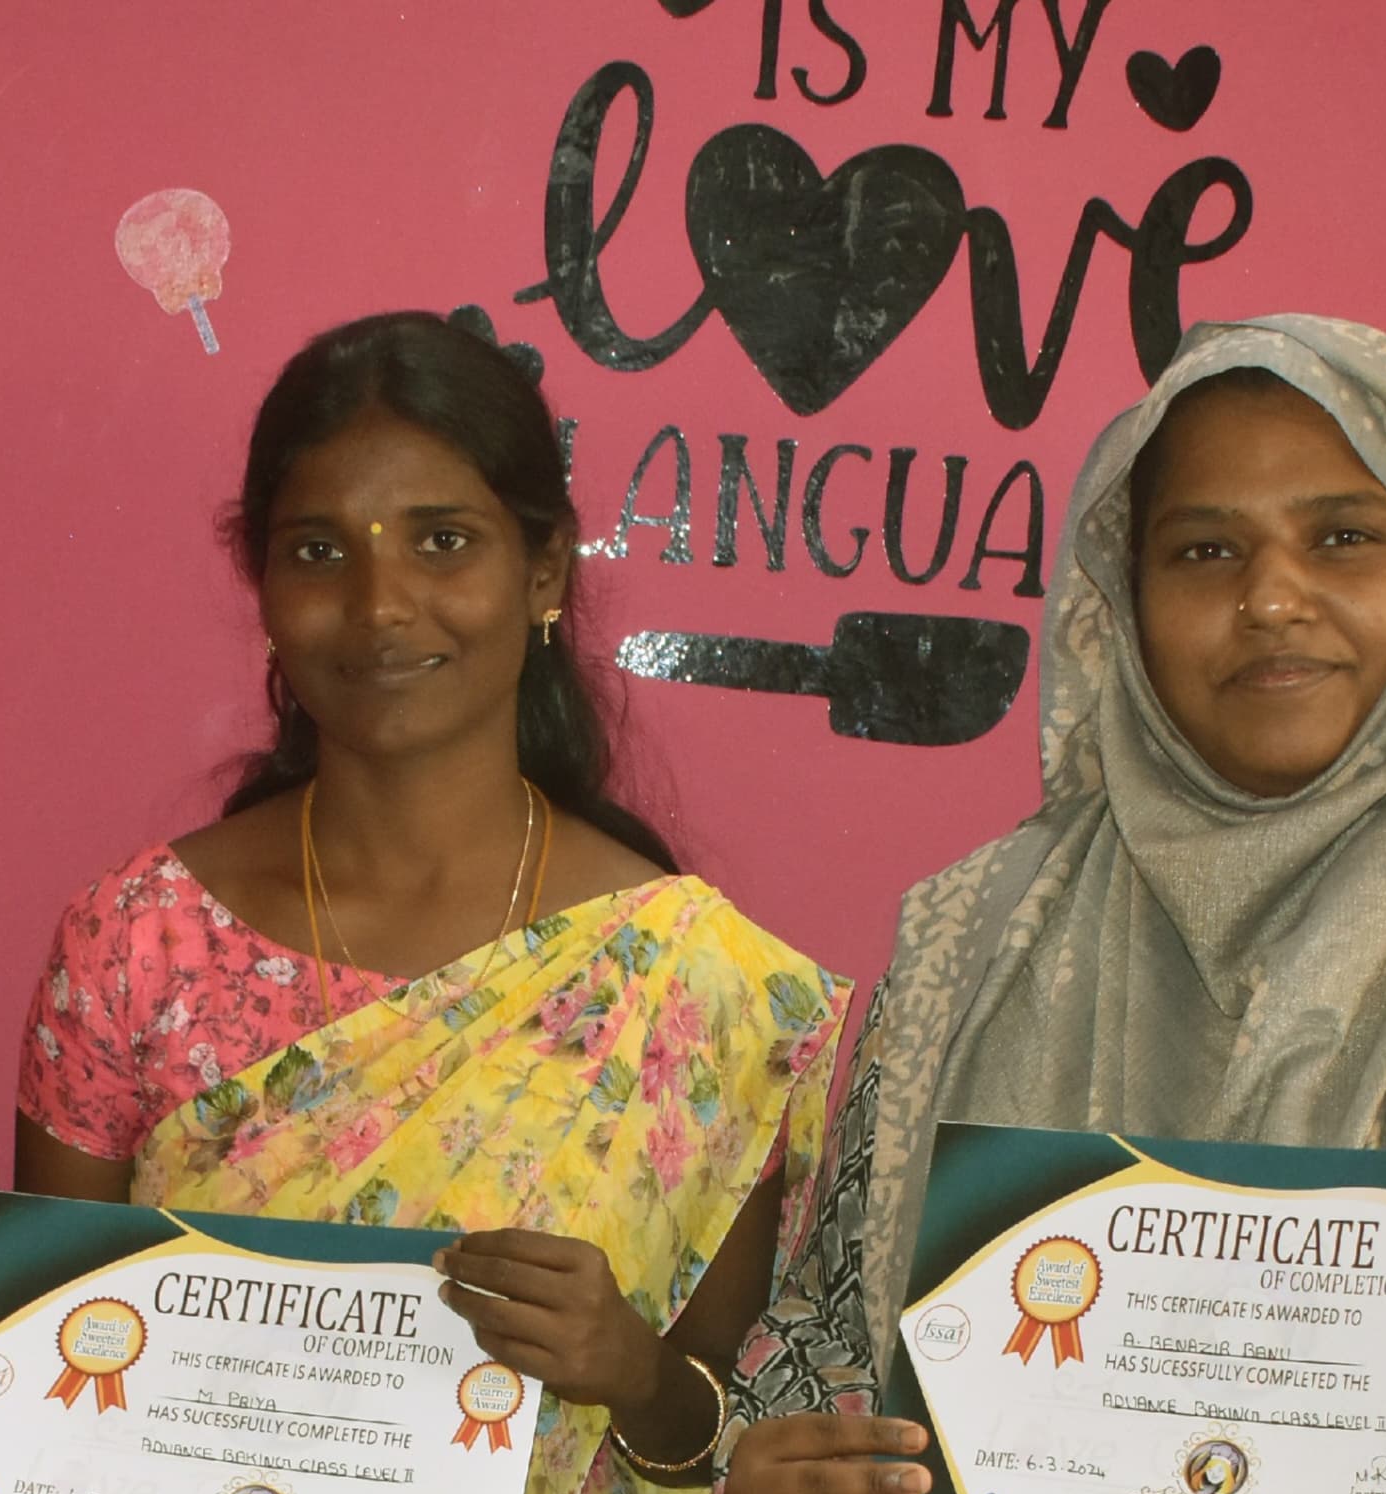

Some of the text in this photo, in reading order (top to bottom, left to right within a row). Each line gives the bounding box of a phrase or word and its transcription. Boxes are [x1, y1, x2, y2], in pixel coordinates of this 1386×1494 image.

[755, 0, 1117, 130] IS MY
[556, 418, 1046, 598] LANGUA
[1107, 1204, 1380, 1269] CERTIFICATE
[1036, 1258, 1087, 1276] Award of
[1035, 1272, 1080, 1289] Sweetest
[1260, 1269, 1286, 1291] OF
[154, 1271, 422, 1339] CERTIFICATE
[1028, 1285, 1083, 1305] Excellence
[1127, 1292, 1363, 1327] THIS CERTIFICATE IS AWARDED TO
[84, 1316, 133, 1334] Award of
[72, 1339, 127, 1360] Excellence
[81, 1330, 125, 1347] Sweetest
[1150, 1335, 1230, 1357] BENAZIR
[302, 1333, 454, 1367] OF COMPLETION
[171, 1351, 405, 1391] THIS CERTIFICATE IS AWARDED TO
[482, 1370, 507, 1386] Best
[1104, 1353, 1371, 1392] HAS SUCESSFULLY COMPLETED THE
[228, 1391, 278, 1412] PRIYA
[470, 1384, 514, 1400] Learner
[471, 1397, 509, 1412] Award
[1102, 1392, 1178, 1416] ADVANCE
[1270, 1410, 1320, 1428] CLASS
[1326, 1411, 1372, 1431] LEVEL
[147, 1404, 413, 1450] HAS SUCESSFULLY COMPLETED THE
[141, 1436, 213, 1460] ADVANCE
[299, 1457, 348, 1478] CLASS
[354, 1463, 398, 1484] LEVEL
[974, 1449, 1020, 1470] DATE:
